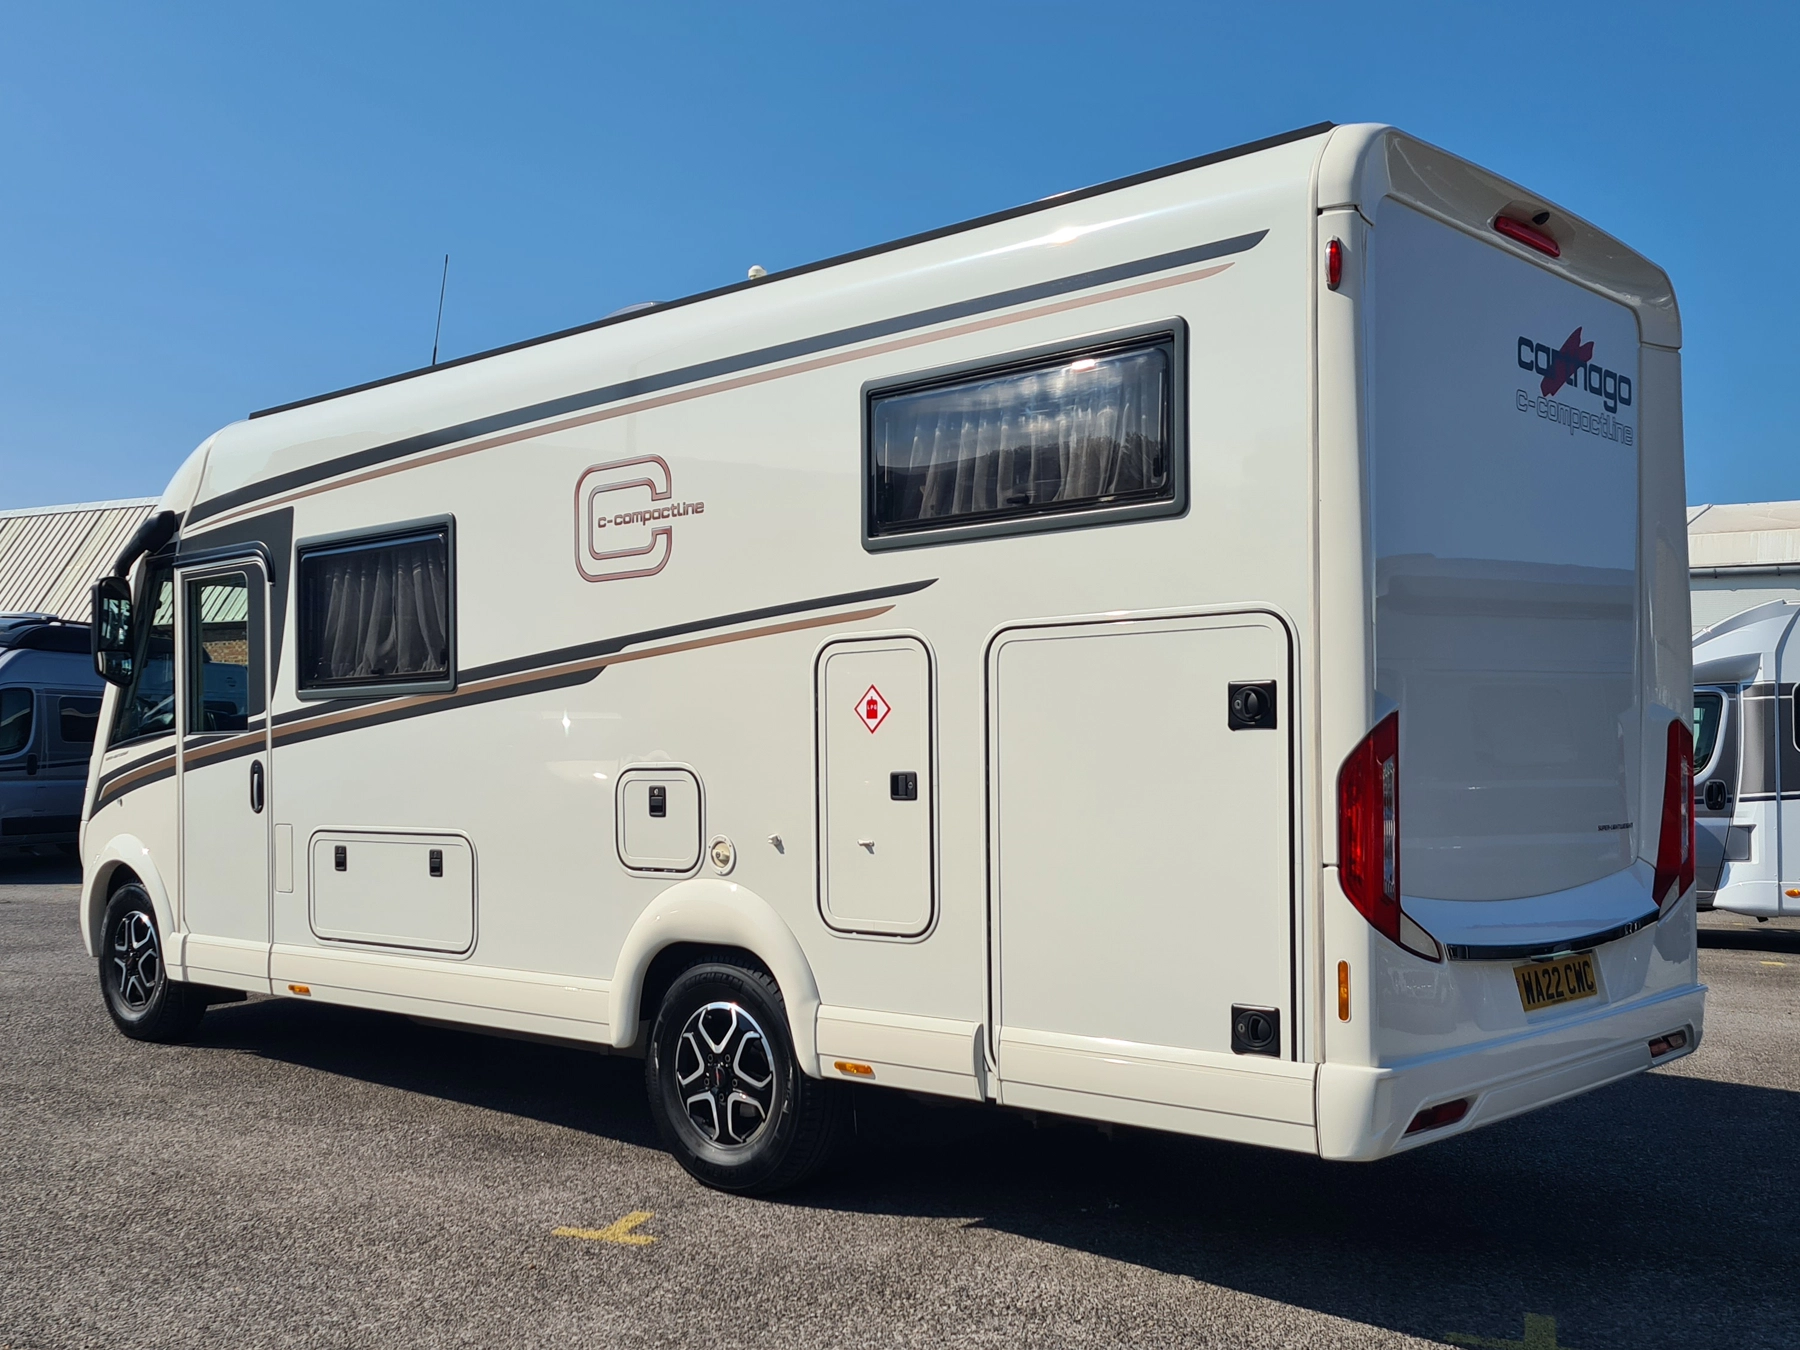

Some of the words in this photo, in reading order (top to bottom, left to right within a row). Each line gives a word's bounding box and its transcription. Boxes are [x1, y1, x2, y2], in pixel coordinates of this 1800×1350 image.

[1515, 388, 1633, 447] c-compactline
[597, 501, 705, 529] c-compactline
[1521, 966, 1564, 1005] WA22
[1564, 960, 1594, 995] CWC
